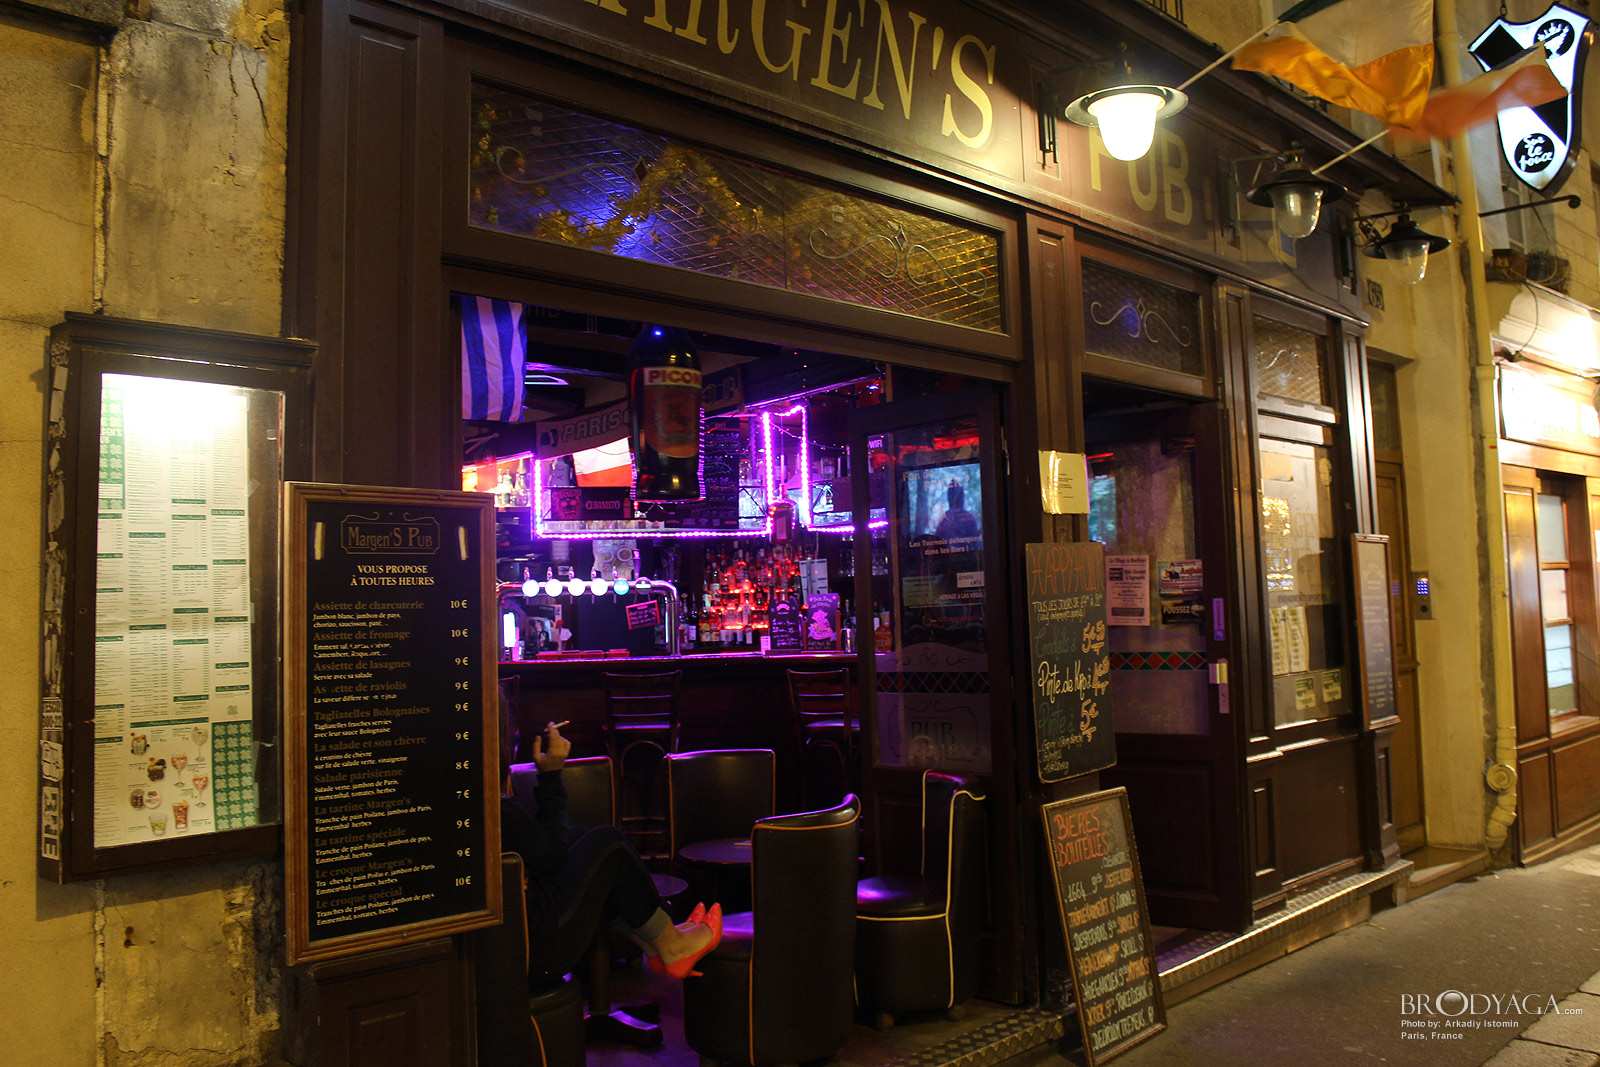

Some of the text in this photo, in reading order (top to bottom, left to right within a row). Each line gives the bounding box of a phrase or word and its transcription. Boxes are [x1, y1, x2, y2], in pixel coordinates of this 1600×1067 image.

[583, 0, 996, 149] GEN'S
[1370, 283, 1383, 308] 65
[649, 370, 702, 385] PICON
[357, 565, 428, 574] VOUS PROPOSE
[350, 574, 434, 586] À TOUTES HEURES
[313, 602, 352, 610] Assiette
[355, 601, 366, 610] de
[369, 600, 424, 610] charcuterie
[1163, 606, 1190, 614] POUSSEZ
[313, 632, 352, 640] Assiette
[355, 630, 366, 640] de
[370, 630, 410, 640] fromage
[314, 662, 354, 671] Assiette
[356, 660, 368, 670] de
[370, 660, 411, 670] lasagnes
[314, 684, 354, 694] Asette
[356, 683, 368, 692] de
[370, 682, 407, 692] raviolis
[314, 708, 370, 722] Tagliatelles
[372, 706, 430, 718] Bolognaises
[360, 727, 390, 735] Bolognaise
[314, 744, 326, 752] La
[328, 740, 360, 751] salade
[362, 740, 372, 748] et
[374, 738, 392, 748] son
[314, 772, 348, 784] Salade
[350, 769, 404, 782] parisienne
[314, 806, 327, 816] La
[330, 803, 364, 814] tartine
[366, 798, 412, 810] Margen's
[316, 838, 328, 847] La
[330, 834, 365, 845] tartine
[316, 870, 328, 878] Le
[330, 864, 366, 876] croque
[316, 900, 328, 909] Le
[330, 895, 366, 907] croque
